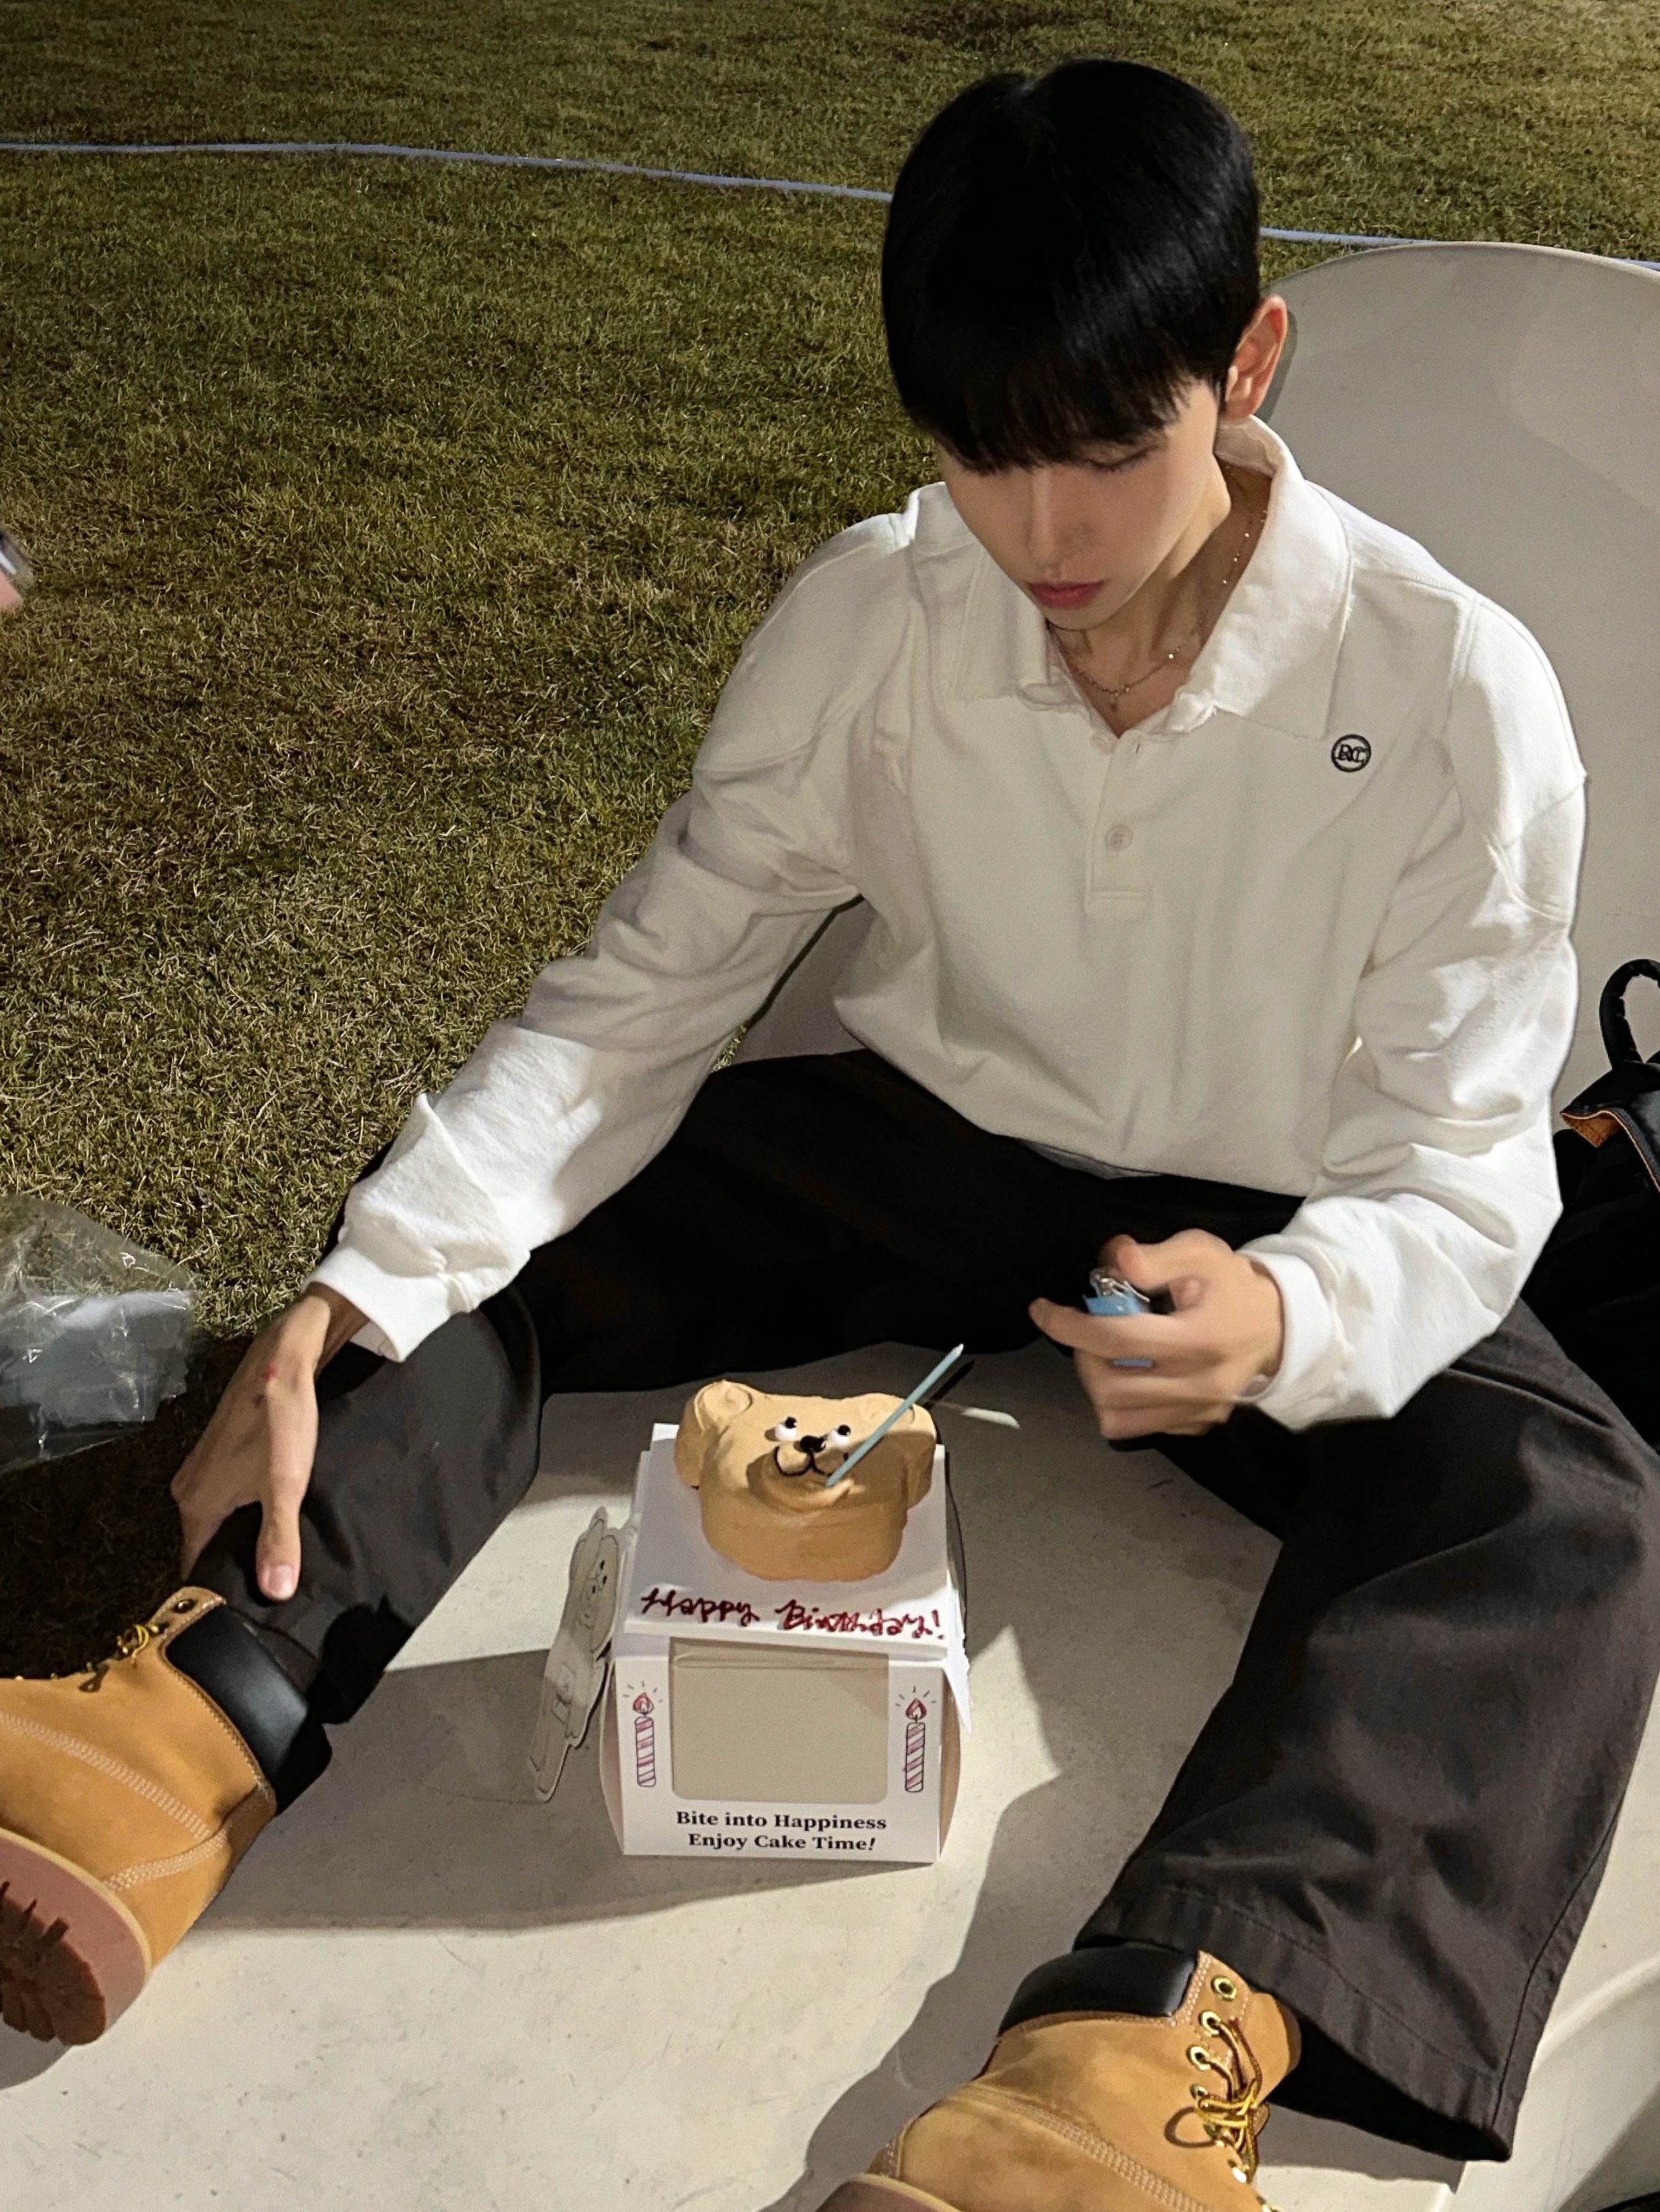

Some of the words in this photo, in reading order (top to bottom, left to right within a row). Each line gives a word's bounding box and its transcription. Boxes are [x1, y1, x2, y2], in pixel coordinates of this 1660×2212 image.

[640, 1587, 760, 1627] Happy
[676, 1810, 719, 1825] Bite
[725, 1811, 767, 1827] into
[774, 1814, 887, 1832] Happiness
[688, 1833, 748, 1850] Enjoy
[754, 1834, 807, 1849] Cake
[811, 1836, 877, 1851] Time!
